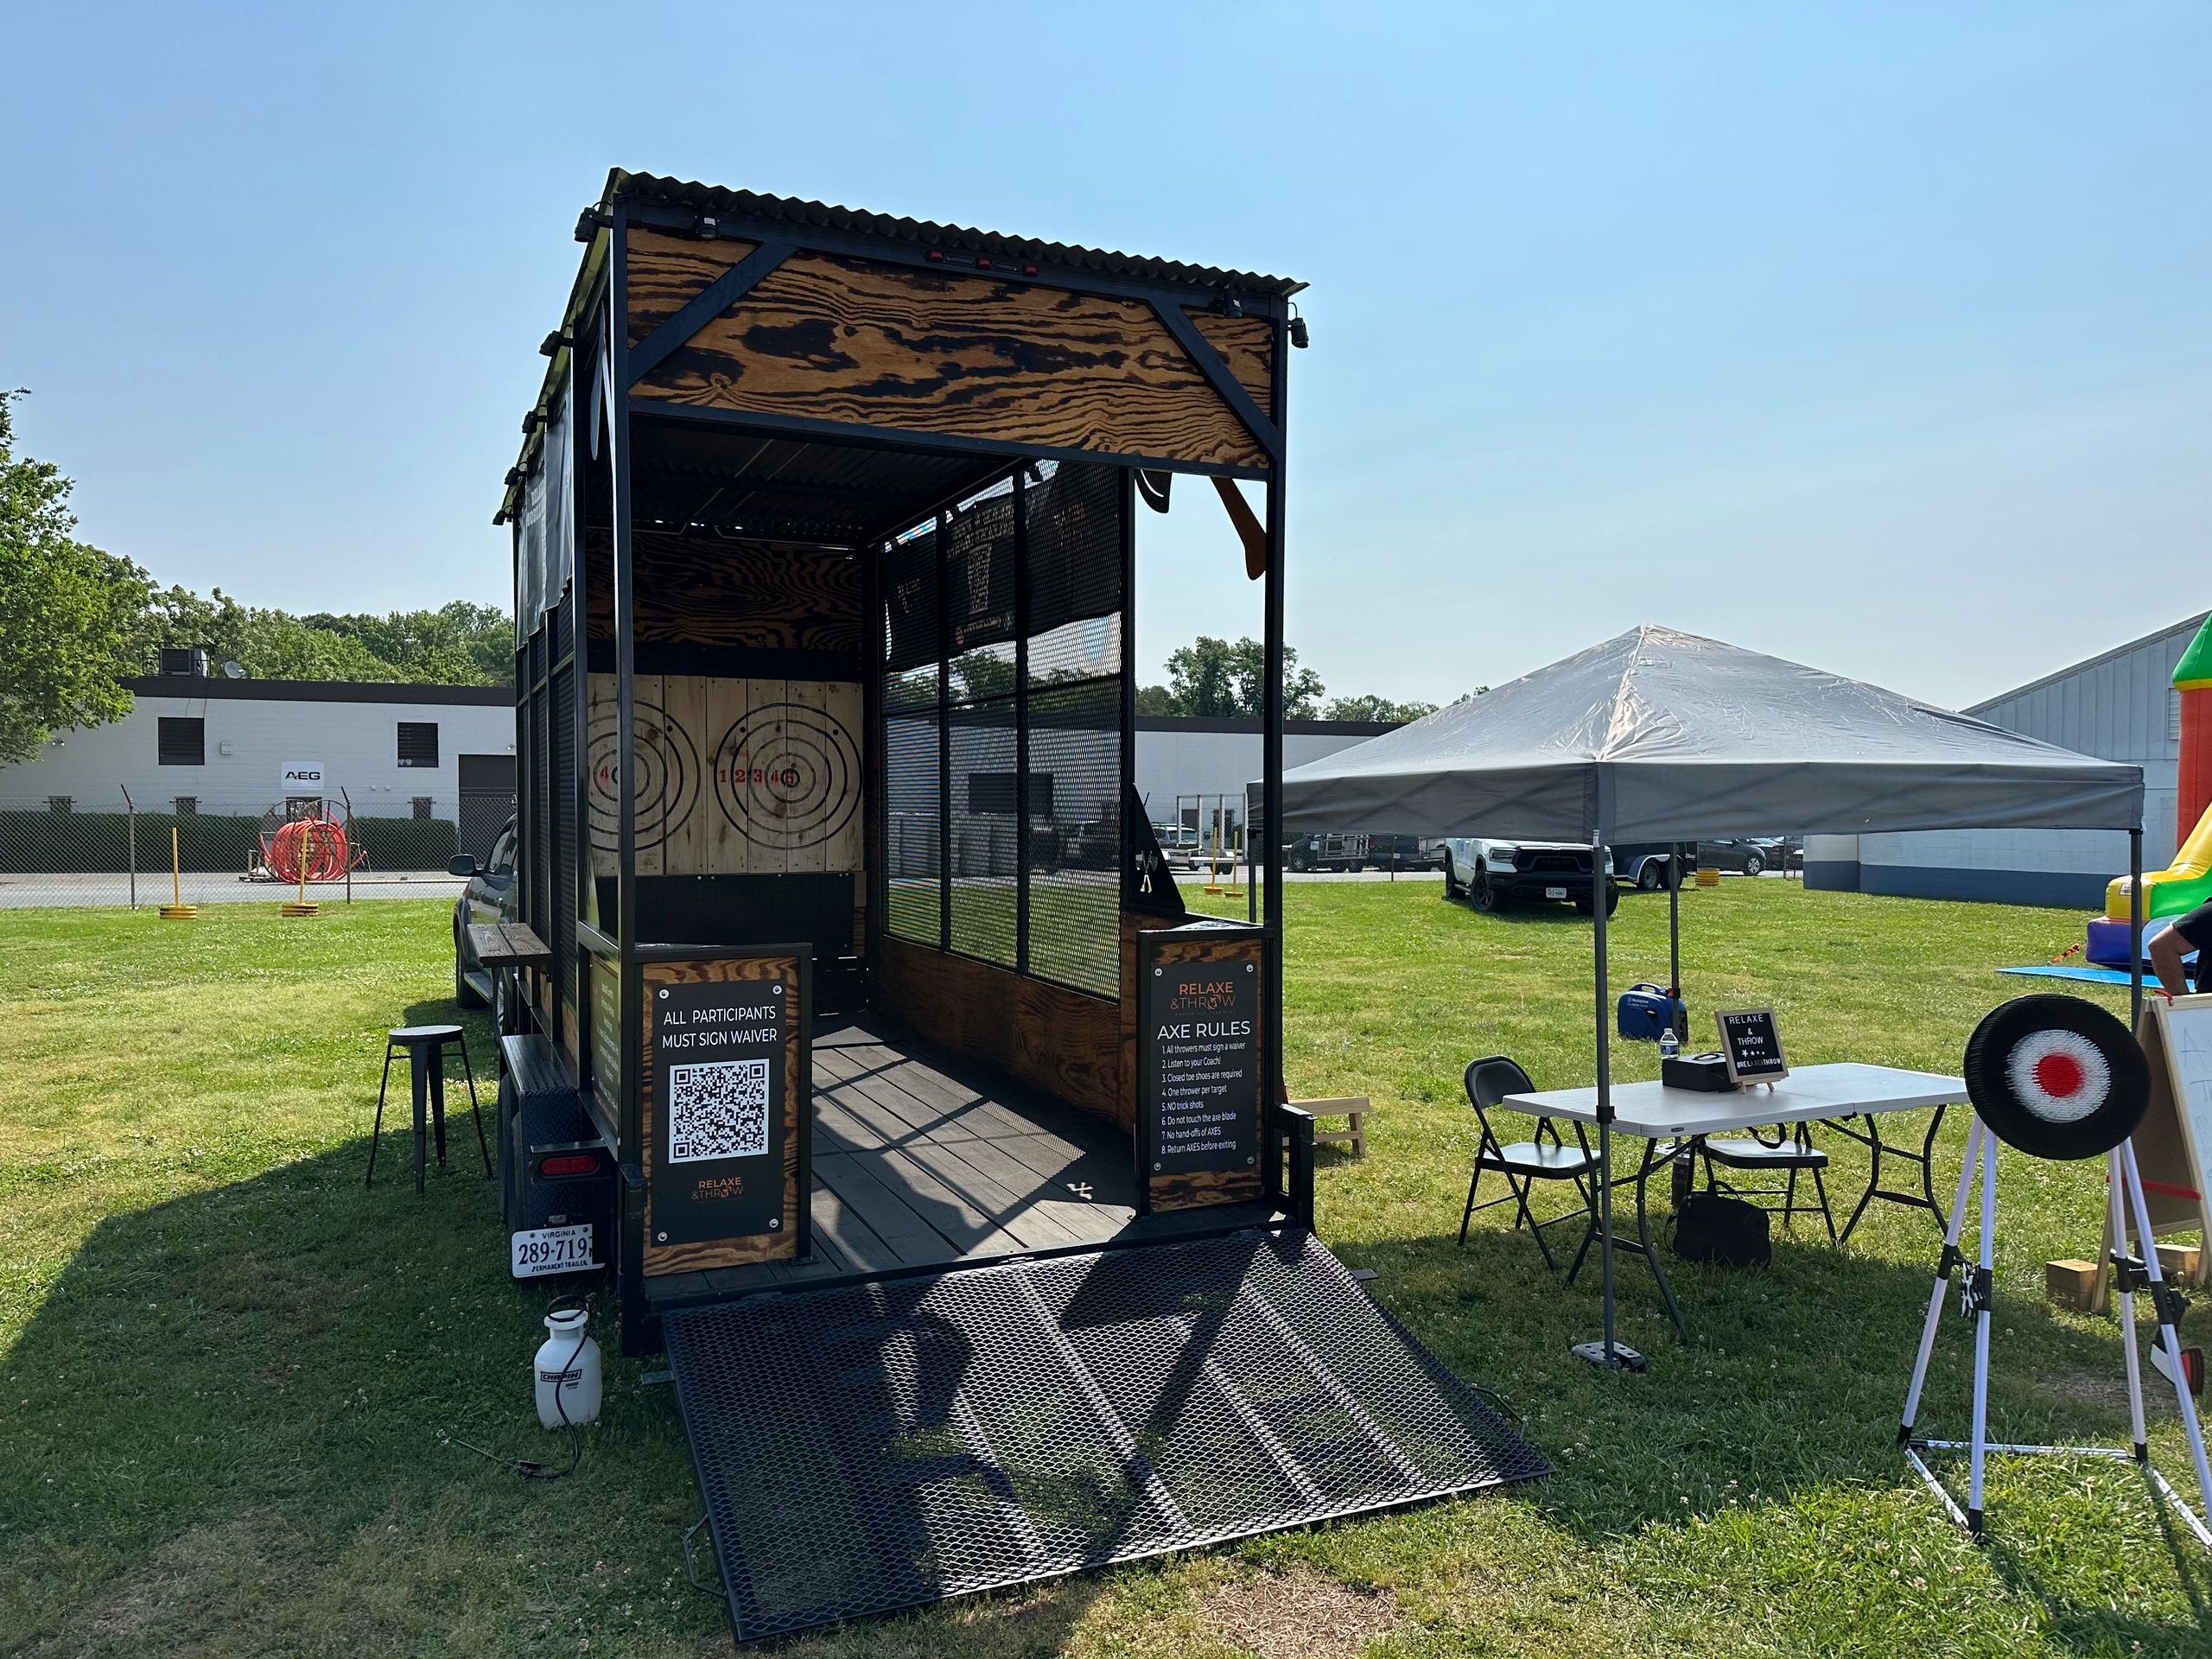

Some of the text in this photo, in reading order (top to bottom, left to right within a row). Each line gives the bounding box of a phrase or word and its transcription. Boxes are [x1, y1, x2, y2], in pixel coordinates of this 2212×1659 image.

[285, 771, 321, 780] AEG
[719, 769, 728, 783] 1
[734, 769, 746, 783] 2
[753, 769, 762, 783] 3
[771, 770, 779, 783] 4
[1179, 982, 1234, 995] RELAXE
[663, 1006, 776, 1026] ALL PARTICIPANTS
[1728, 1014, 1764, 1025] RELAXE
[1157, 1020, 1251, 1040] AXE RULES
[662, 1028, 778, 1049] MUST SIGN WAIVER
[1737, 1036, 1764, 1046] THROW
[1161, 1046, 1166, 1054] 1.
[1174, 1044, 1198, 1053] throwers
[1198, 1043, 1211, 1052] must
[1212, 1041, 1224, 1053] sign
[1229, 1040, 1246, 1050] waiver
[1161, 1056, 1222, 1069] 2. Listen to your Coach!
[1161, 1073, 1166, 1083] 3.
[1167, 1072, 1185, 1083] Closed
[1185, 1072, 1194, 1081] toe
[1195, 1071, 1211, 1080] shoes
[1220, 1068, 1243, 1080] required
[1161, 1084, 1228, 1096] 4. One thrower per target
[1161, 1099, 1205, 1111] 5. NO trick shots
[1161, 1116, 1166, 1126] 6.
[1167, 1116, 1176, 1125] Do
[1176, 1116, 1185, 1125] not
[1185, 1114, 1201, 1124] touch
[1202, 1113, 1211, 1122] the
[1222, 1110, 1236, 1121] blade
[1161, 1126, 1222, 1140] 7. No hand-offs of AXES
[1161, 1139, 1236, 1154] 8. Return AXES before exiting
[698, 1177, 742, 1190] RELAXE
[542, 1230, 576, 1239] VIRGINIA
[518, 1237, 588, 1265] 289-719
[531, 1260, 588, 1273] PERMANENT TRAILER
